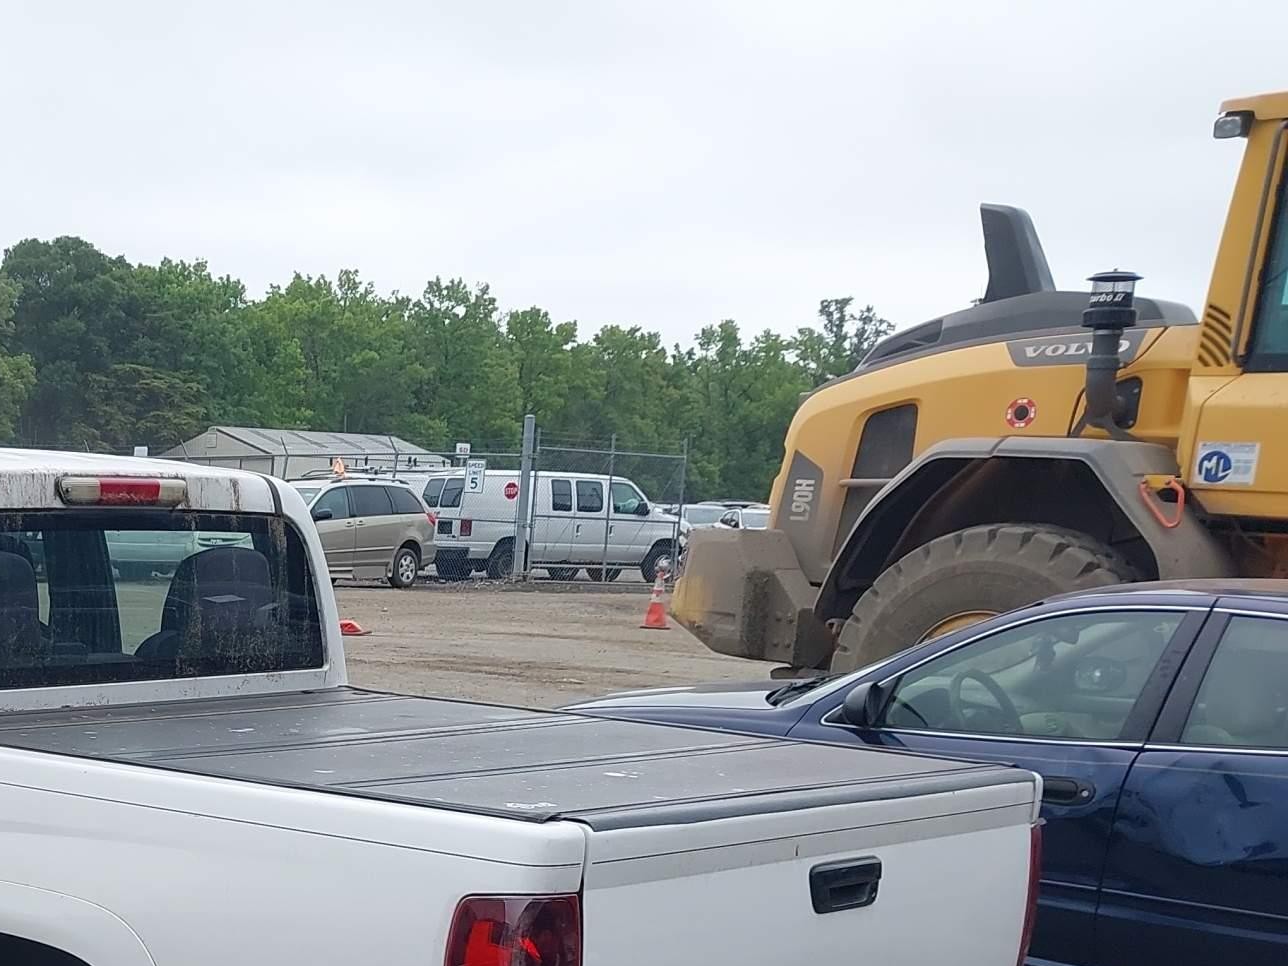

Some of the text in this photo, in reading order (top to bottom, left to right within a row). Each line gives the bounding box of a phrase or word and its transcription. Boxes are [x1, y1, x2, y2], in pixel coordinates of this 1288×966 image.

[470, 478, 478, 489] 5
[505, 487, 518, 495] STOP
[789, 479, 816, 521] L90H
